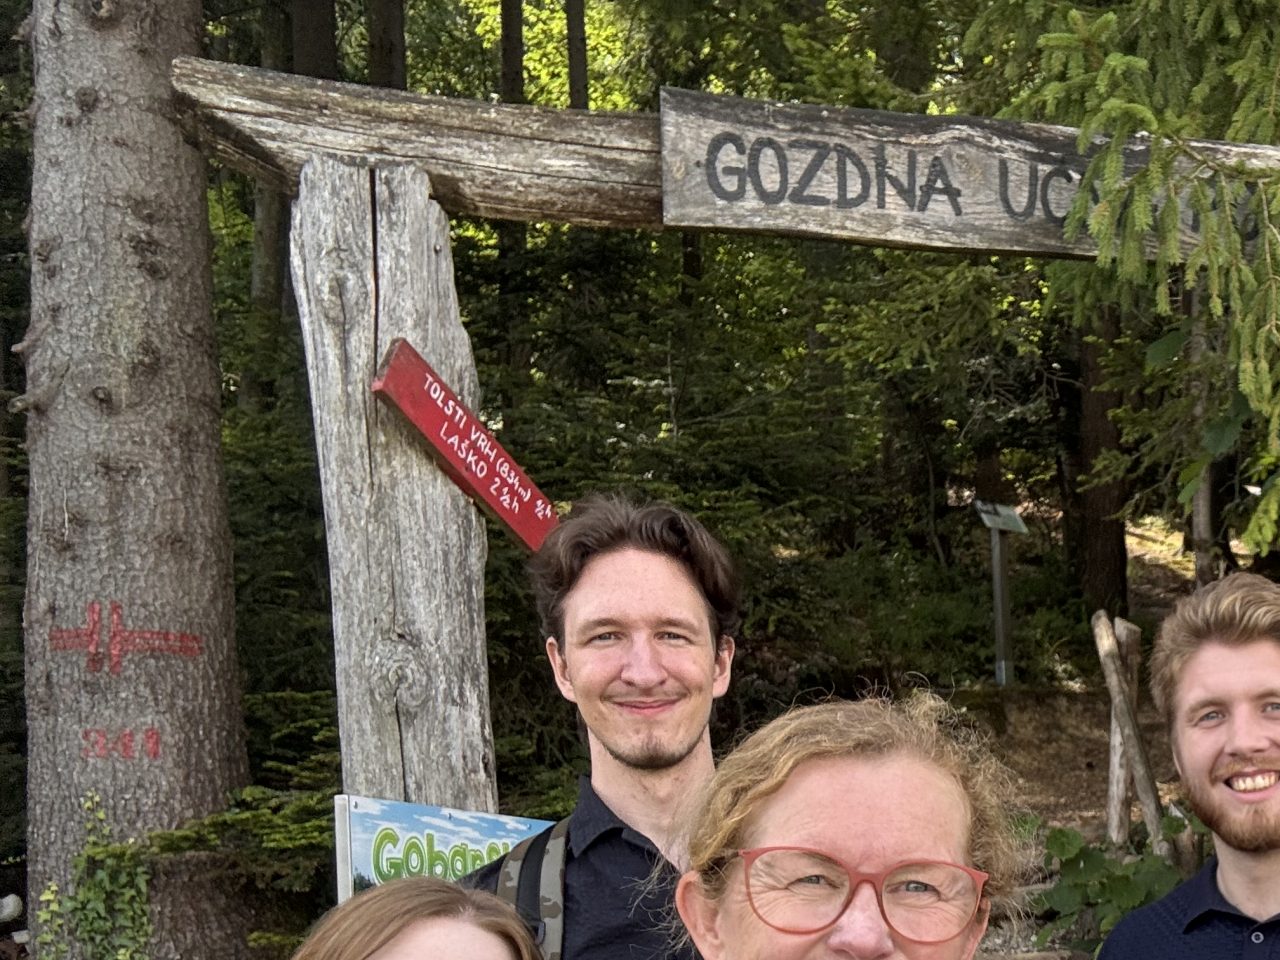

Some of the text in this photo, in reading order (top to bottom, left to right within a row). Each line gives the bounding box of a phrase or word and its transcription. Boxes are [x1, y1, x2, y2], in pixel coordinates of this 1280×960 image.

[705, 131, 962, 216] GOZDNA
[424, 373, 467, 429] TOLSTI
[471, 425, 497, 462] VRH
[440, 422, 488, 478] LAŠKO
[490, 477, 501, 496] 2
